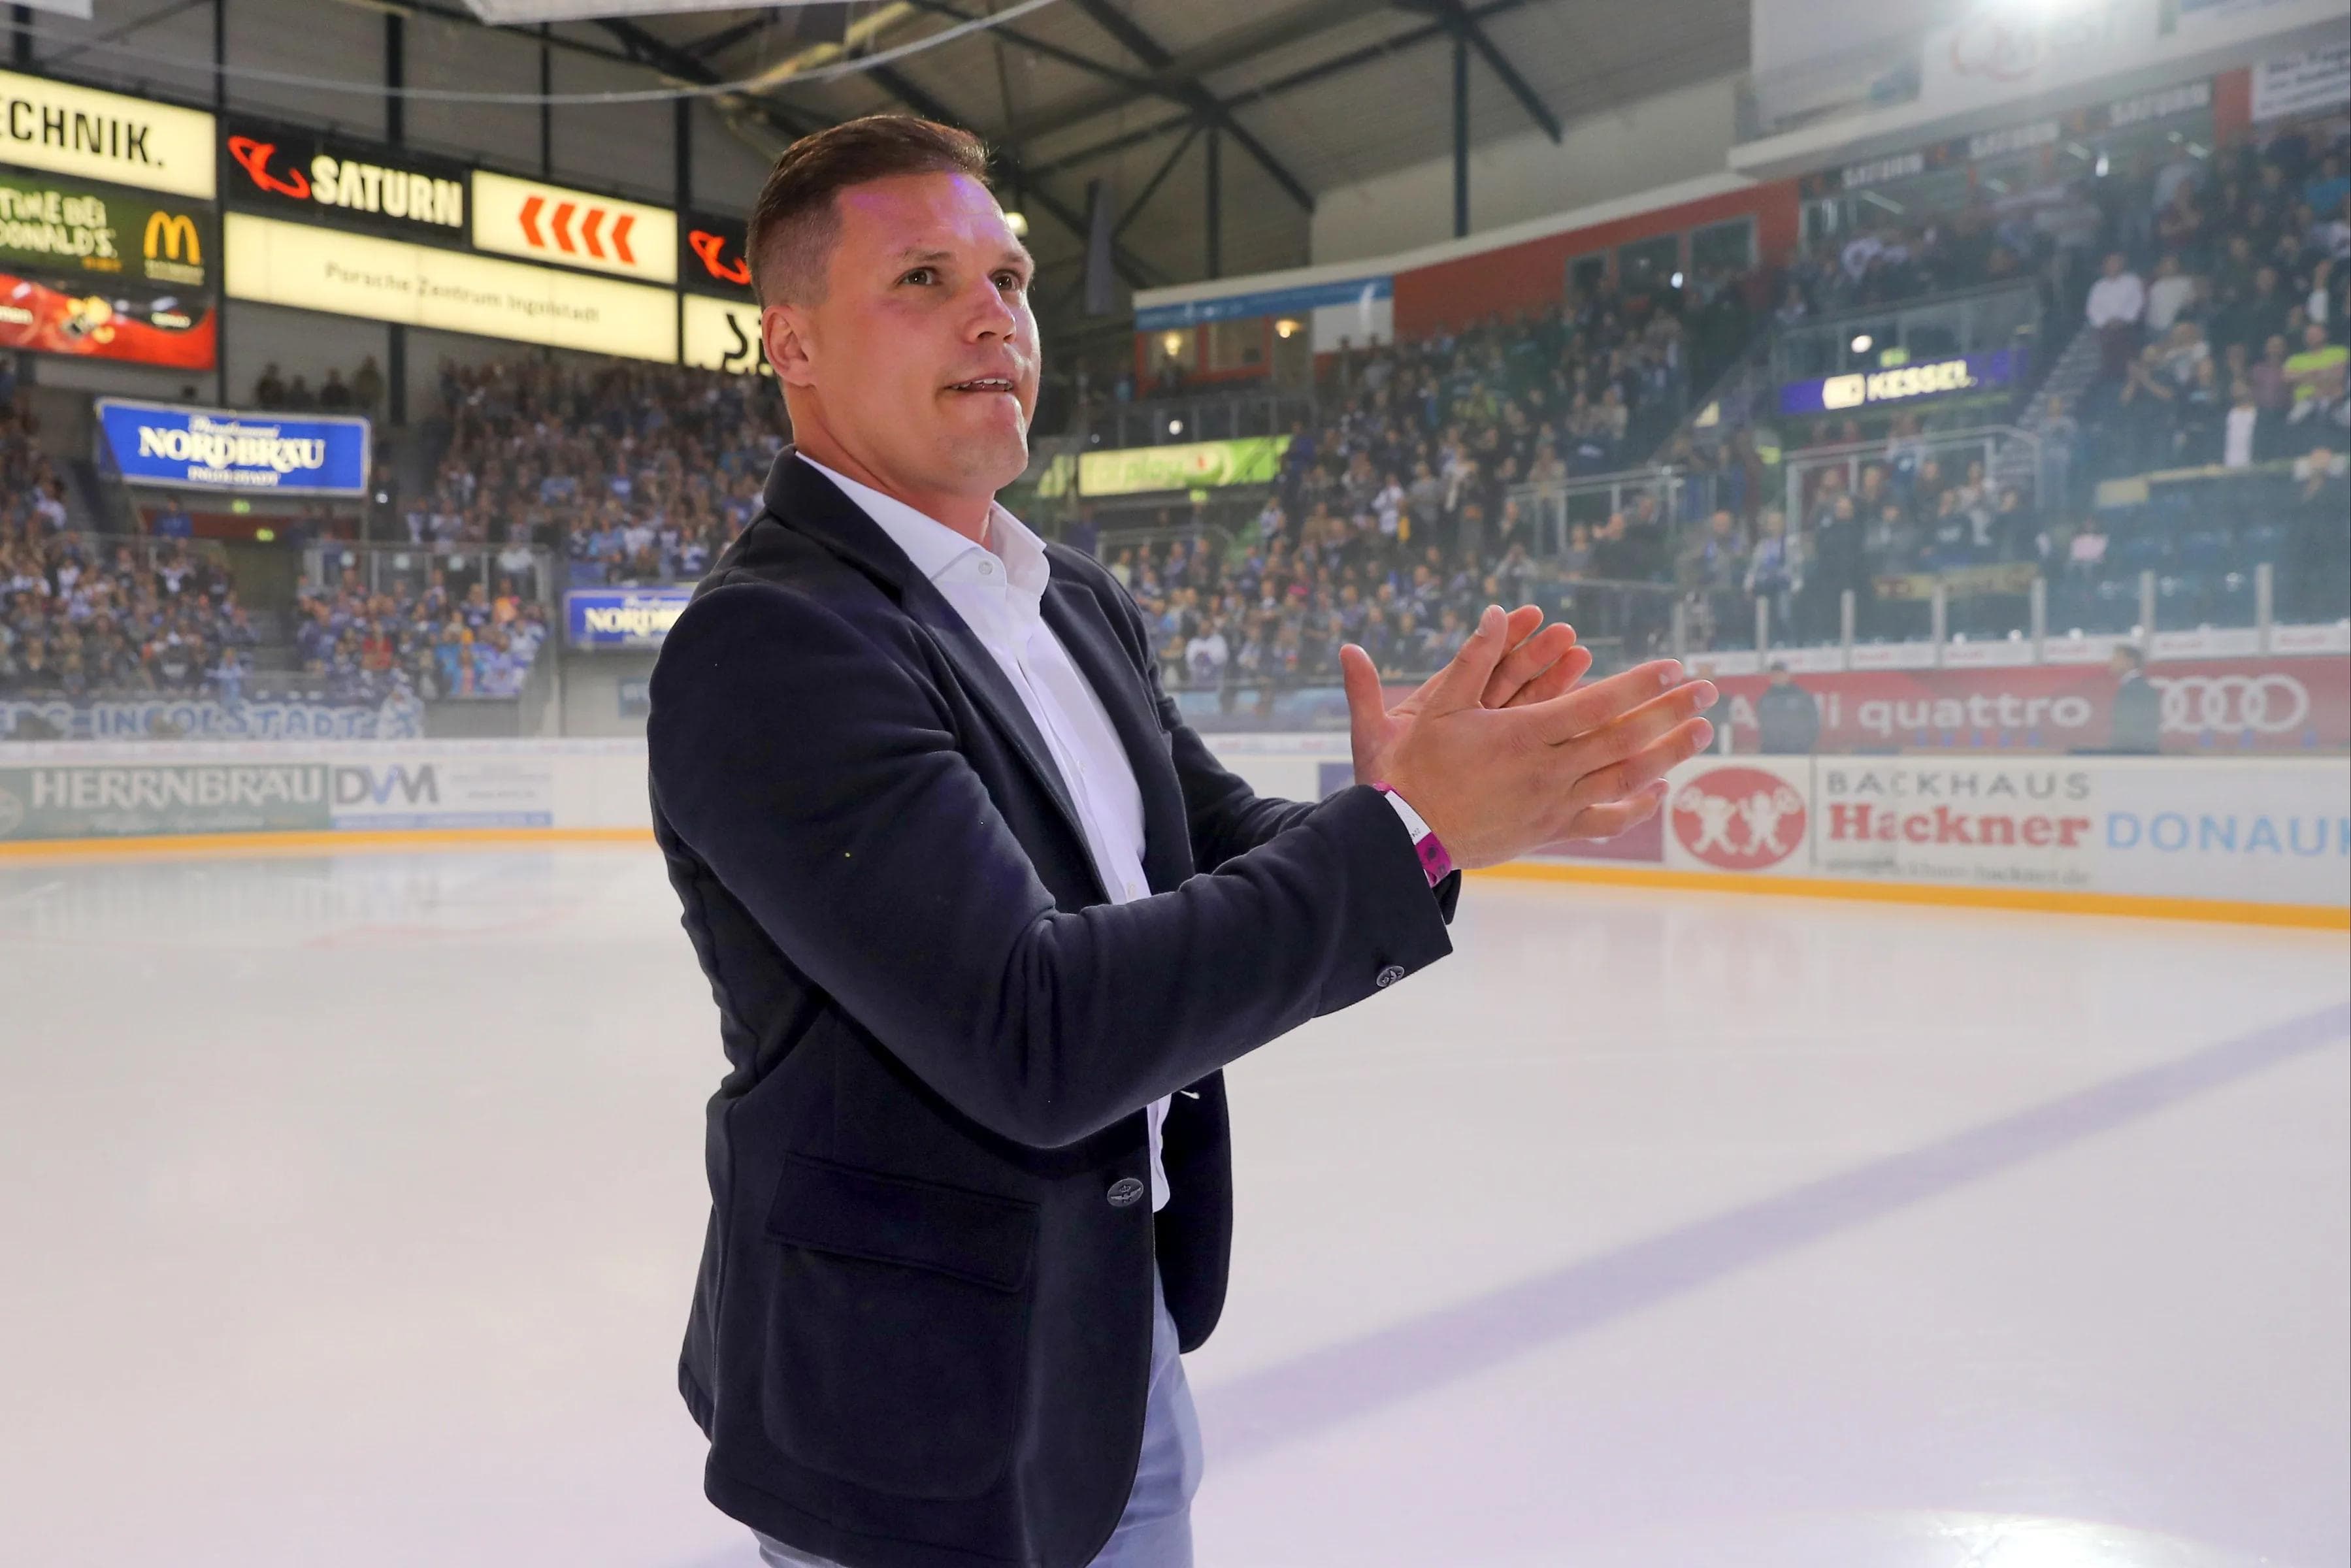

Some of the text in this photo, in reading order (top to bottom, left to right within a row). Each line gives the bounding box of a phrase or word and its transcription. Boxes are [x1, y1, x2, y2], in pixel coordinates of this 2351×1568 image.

[0, 100, 163, 166] CHNIK.
[310, 155, 463, 228] SATURN
[1857, 693, 2092, 738] quattro
[335, 763, 440, 805] DVM
[1827, 771, 2090, 801] BACKHAUS
[1828, 802, 2090, 848] Hackner
